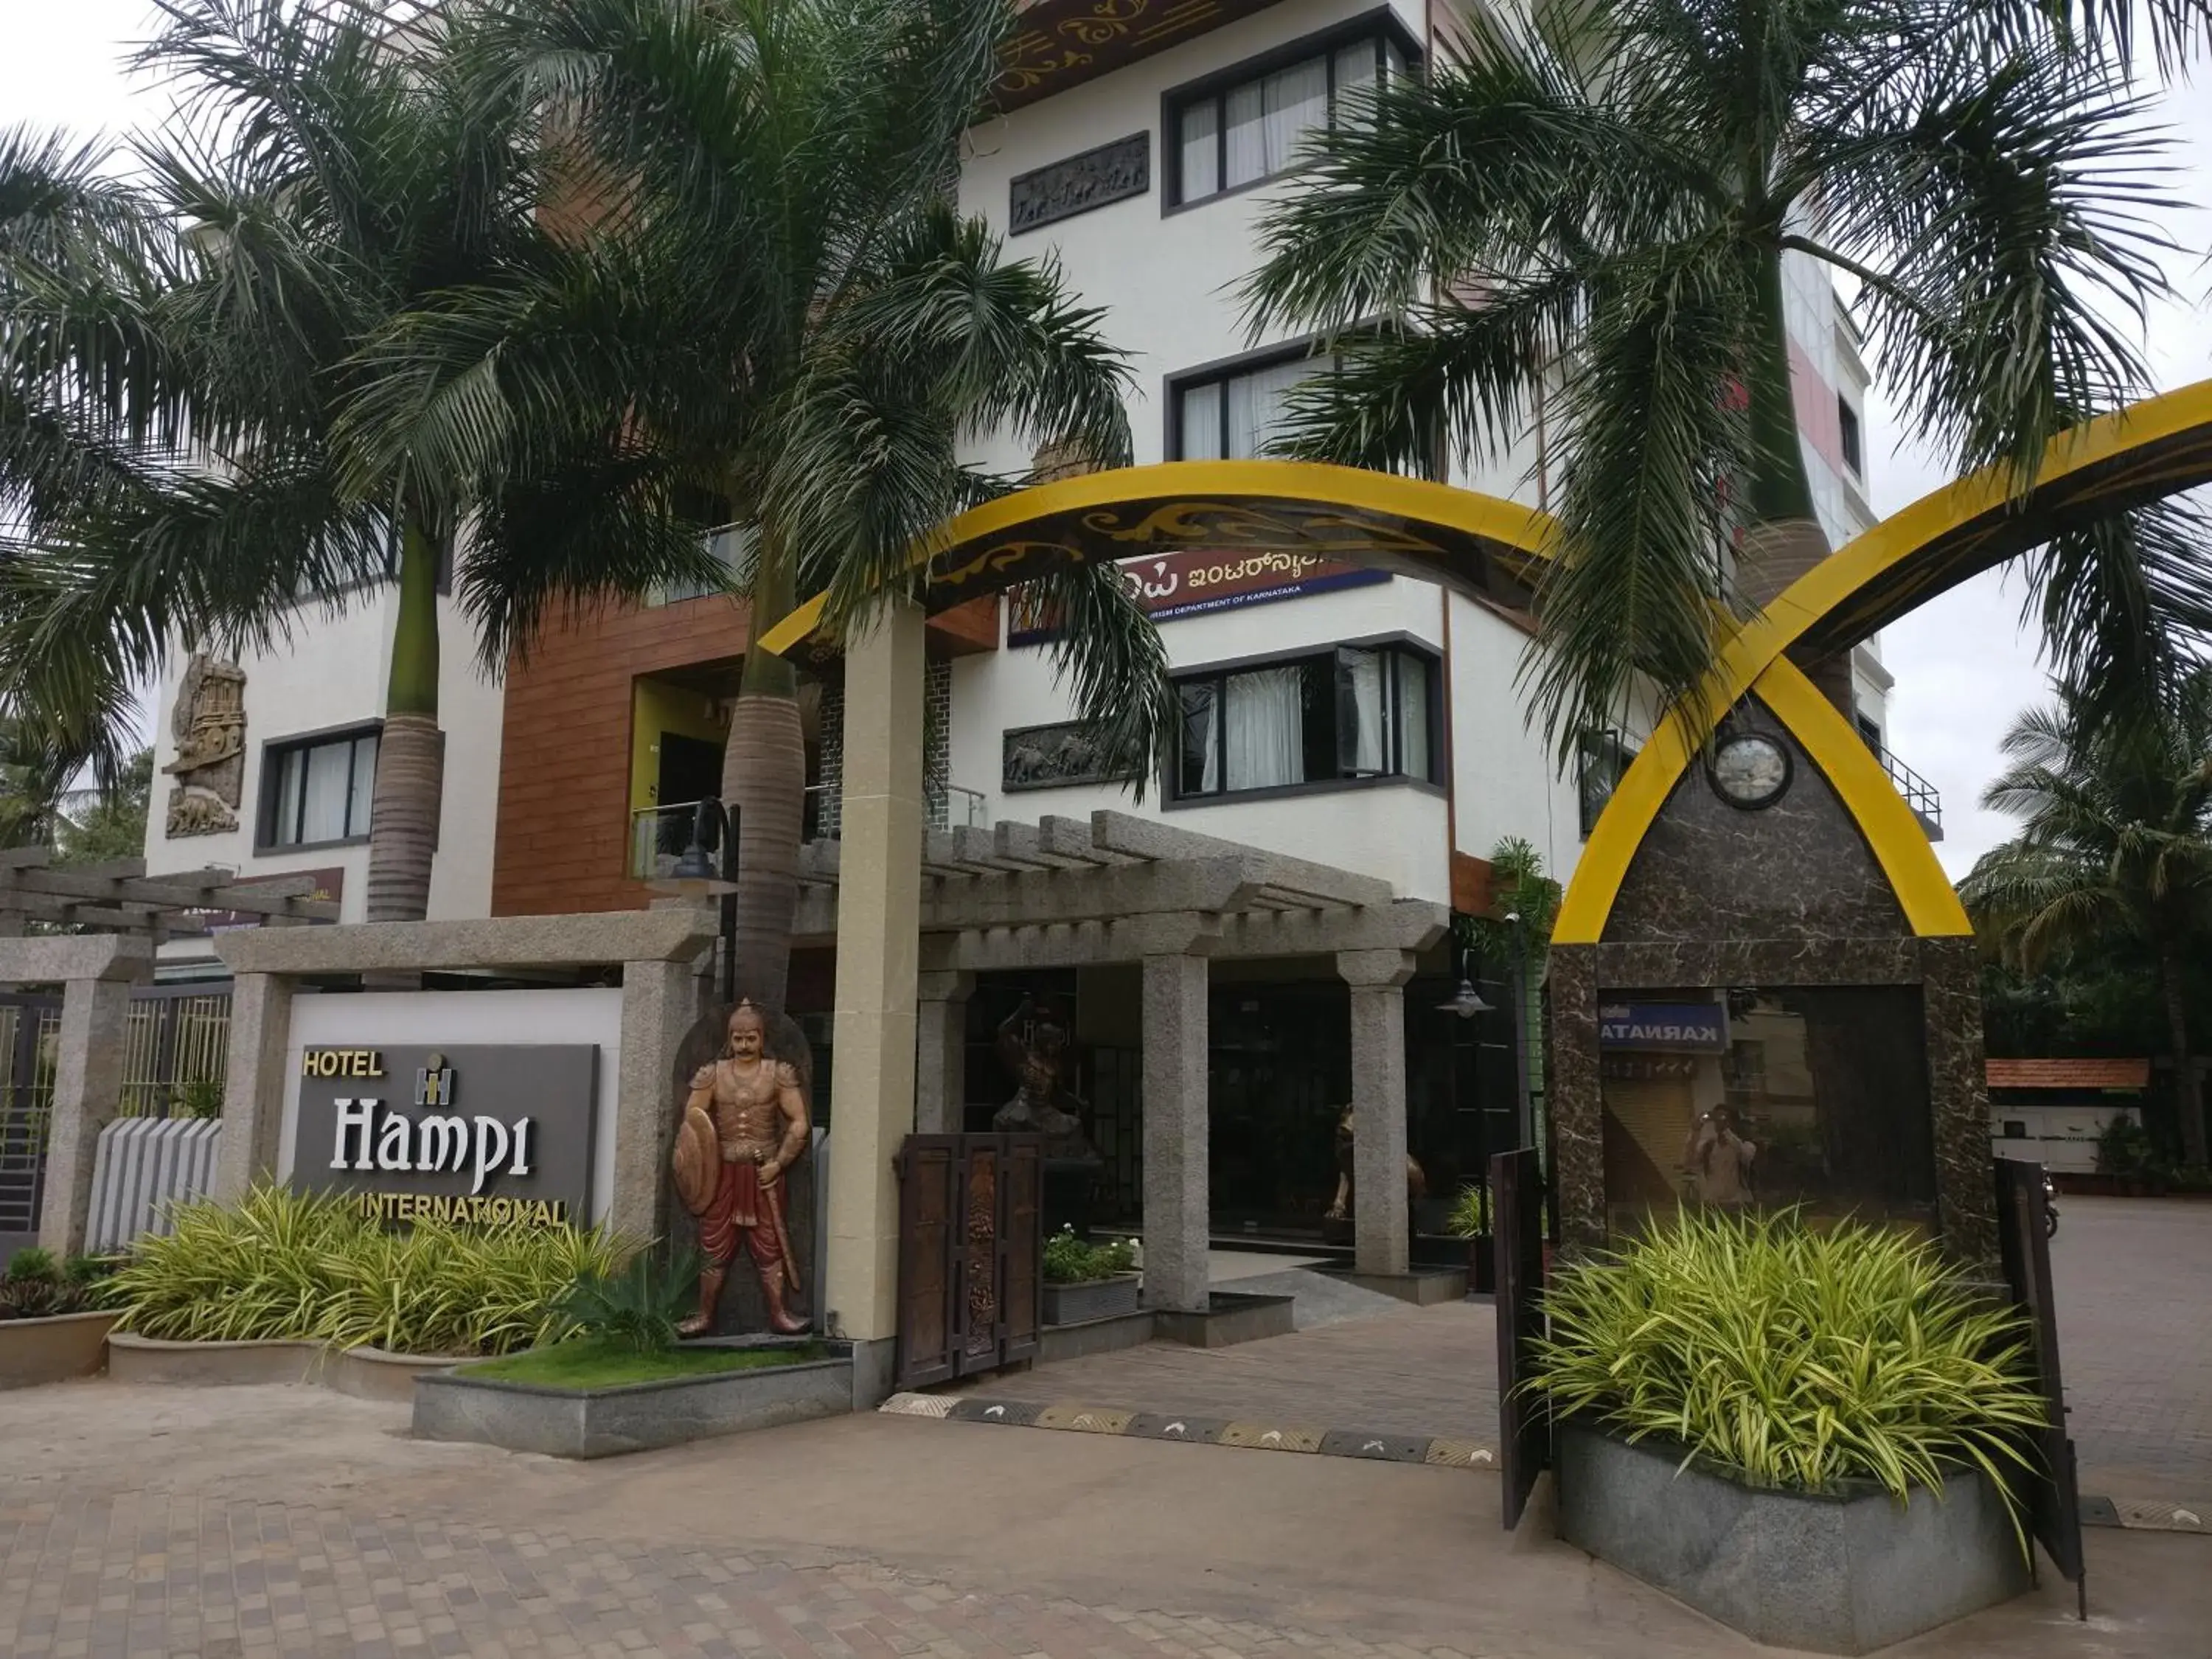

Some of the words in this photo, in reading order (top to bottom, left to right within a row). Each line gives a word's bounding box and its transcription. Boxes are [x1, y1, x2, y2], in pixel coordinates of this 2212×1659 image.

[1175, 598, 1231, 615] DEPARTMENT
[1232, 595, 1244, 604] OF
[1247, 585, 1302, 602] KARNATAKA
[303, 1051, 383, 1077] HOTEL
